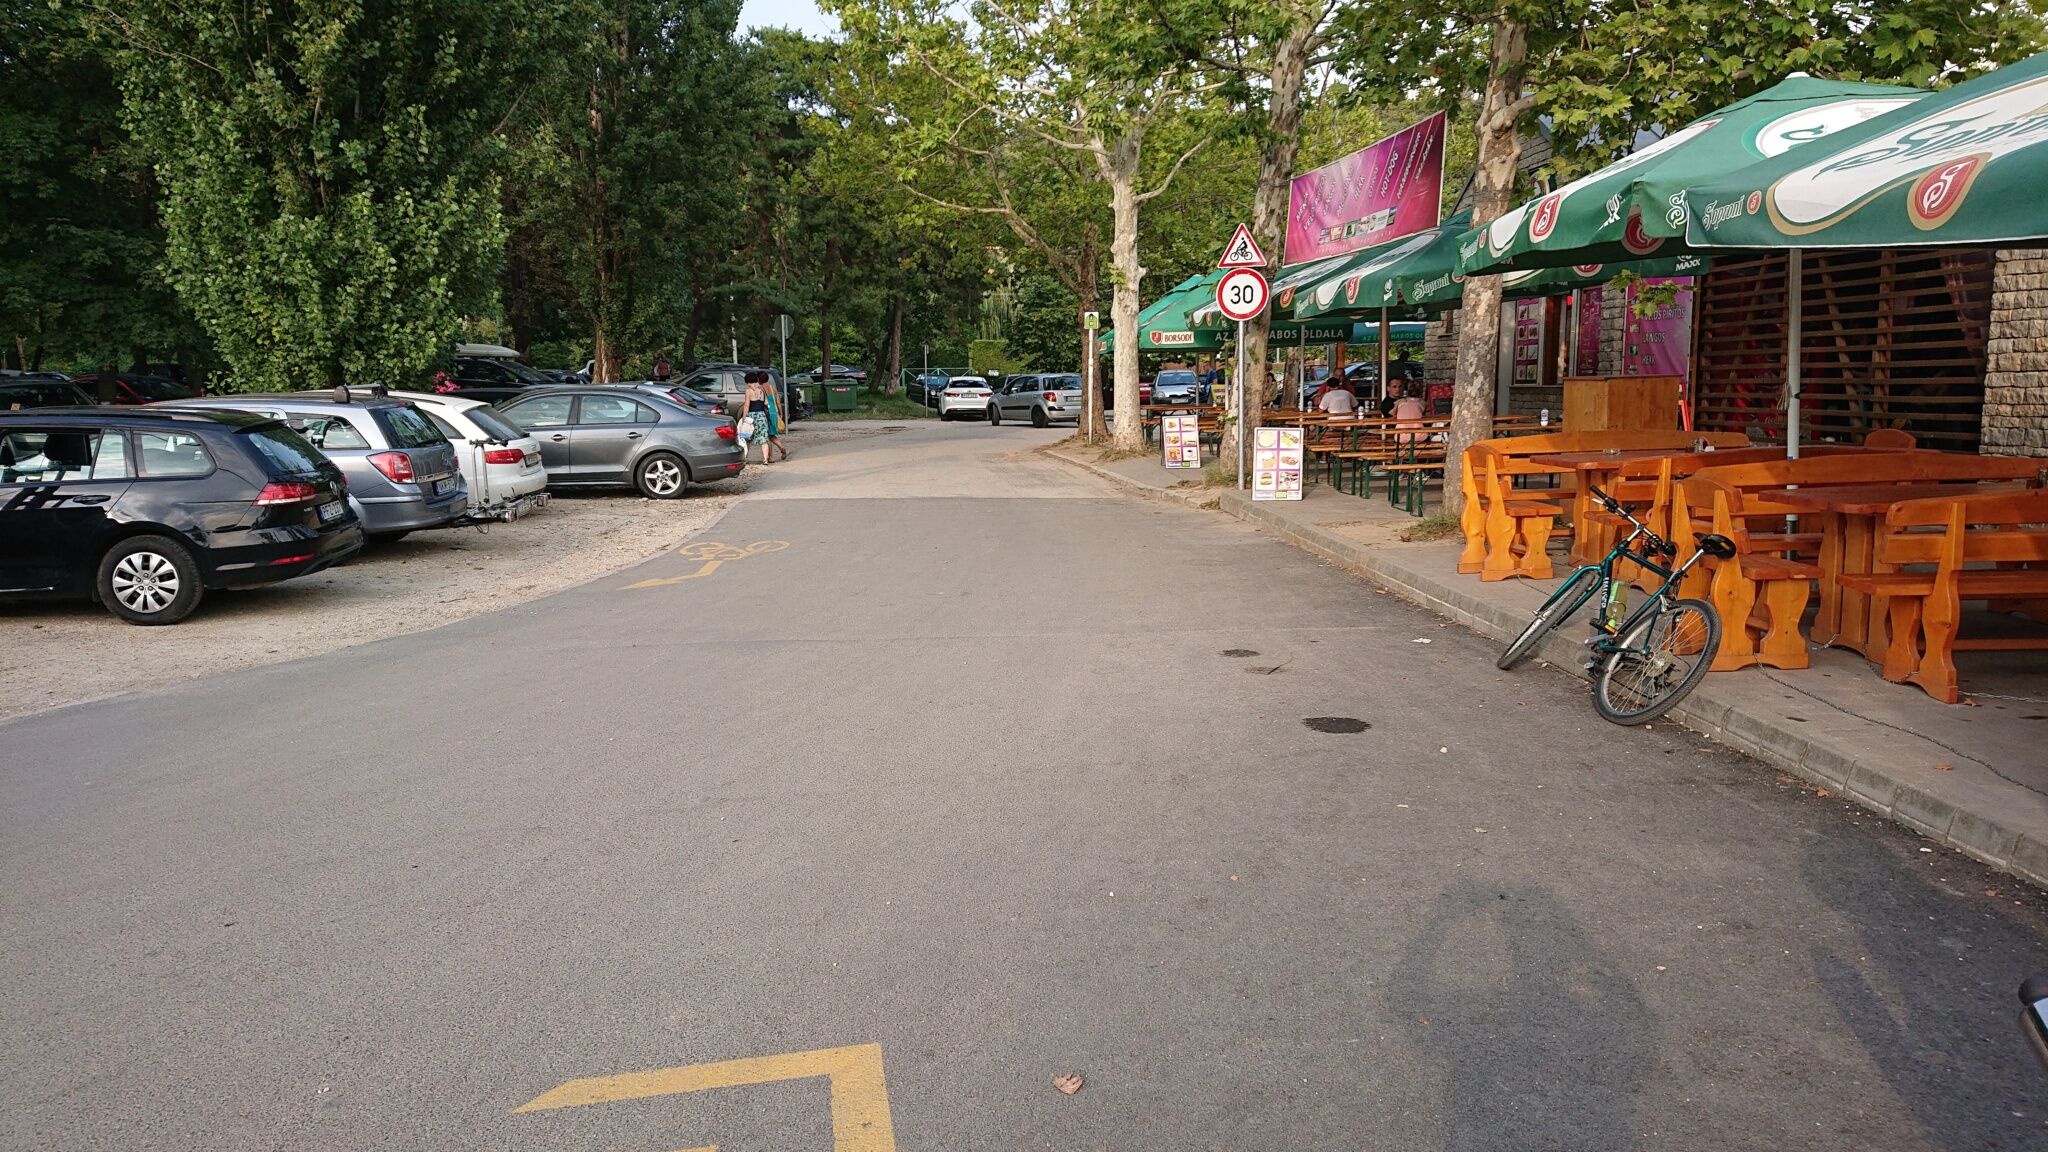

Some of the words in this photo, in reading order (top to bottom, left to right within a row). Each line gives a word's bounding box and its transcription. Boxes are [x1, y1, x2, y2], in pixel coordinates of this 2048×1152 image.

[1381, 150, 1399, 199] HOT-DOG
[1702, 194, 1745, 231] Soproni
[1675, 258, 1701, 271] MAXX
[1230, 284, 1254, 304] 30
[1412, 272, 1450, 301] Soproni
[1164, 334, 1193, 343] BORSODI
[1214, 331, 1229, 342] AZ
[1268, 329, 1298, 339] ABOS
[1303, 329, 1345, 340] OLDALA
